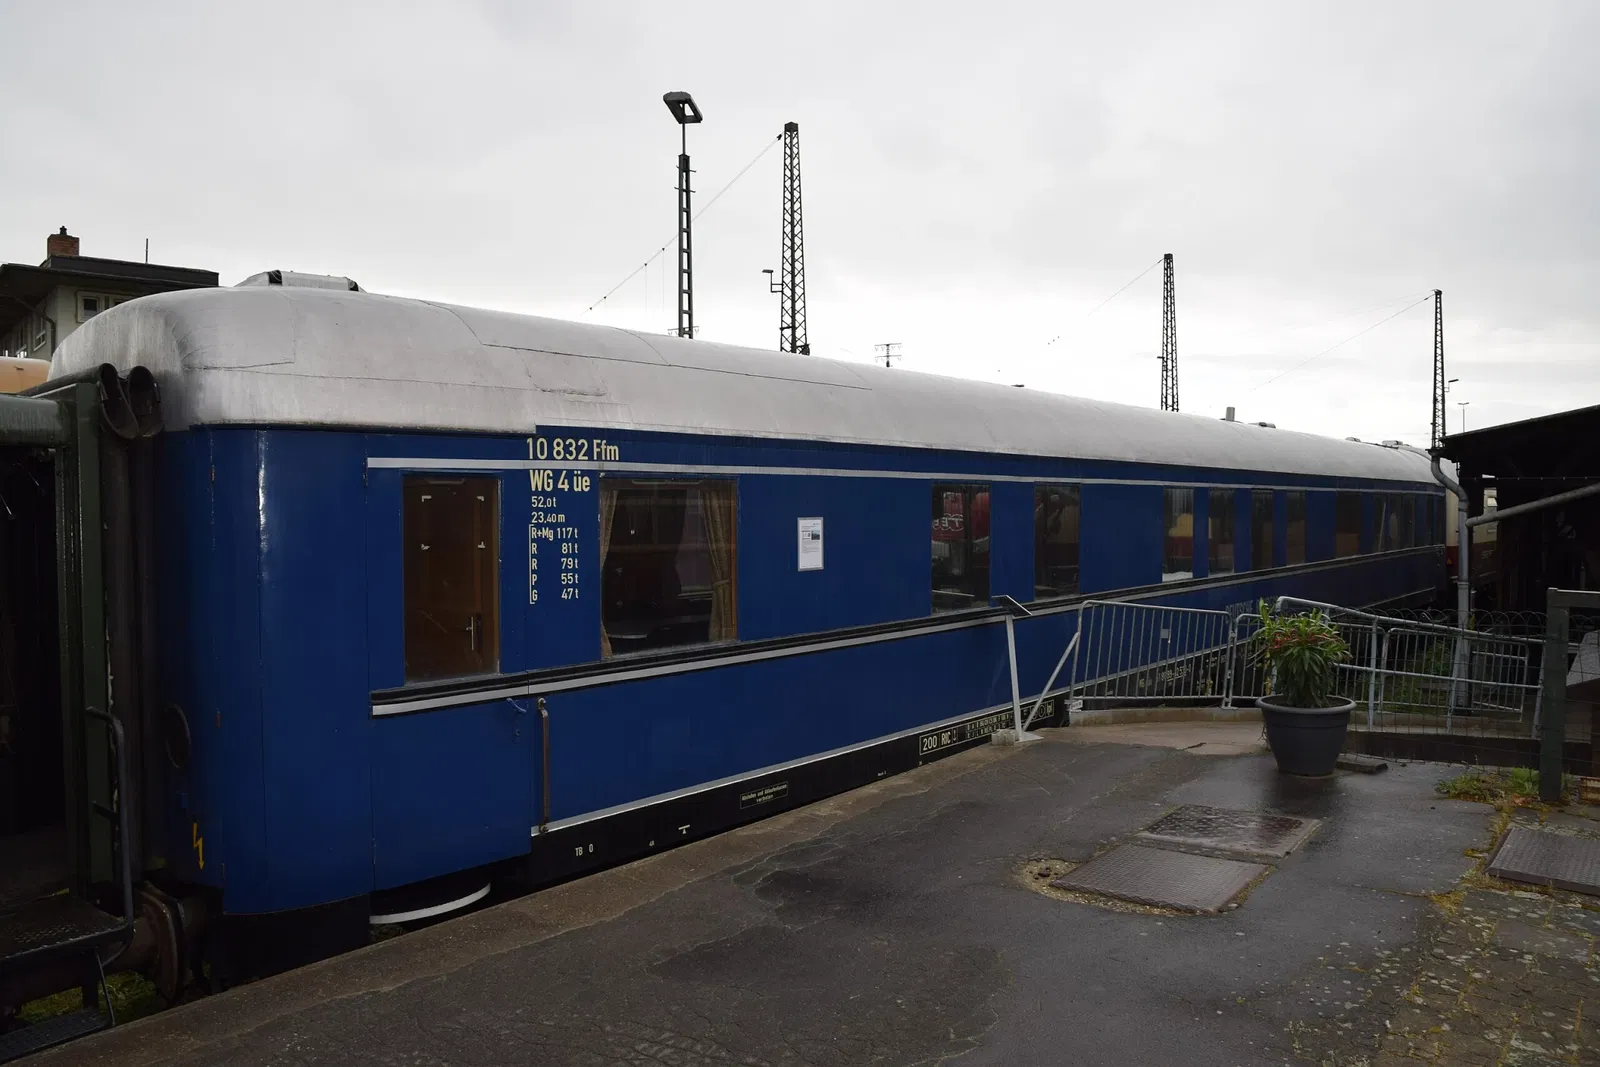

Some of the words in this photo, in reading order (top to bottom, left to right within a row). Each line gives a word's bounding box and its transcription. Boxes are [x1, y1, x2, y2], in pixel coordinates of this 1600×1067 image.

[526, 437, 548, 460] 10
[553, 438, 589, 460] 832
[593, 439, 619, 461] Ffm
[529, 469, 554, 492] WG
[557, 470, 570, 492] 4
[573, 470, 591, 492] üe
[531, 526, 554, 541] R+Mg
[531, 542, 538, 554] R
[531, 558, 538, 570] R
[531, 573, 538, 586] P
[532, 589, 538, 601] G
[922, 734, 938, 751] 200
